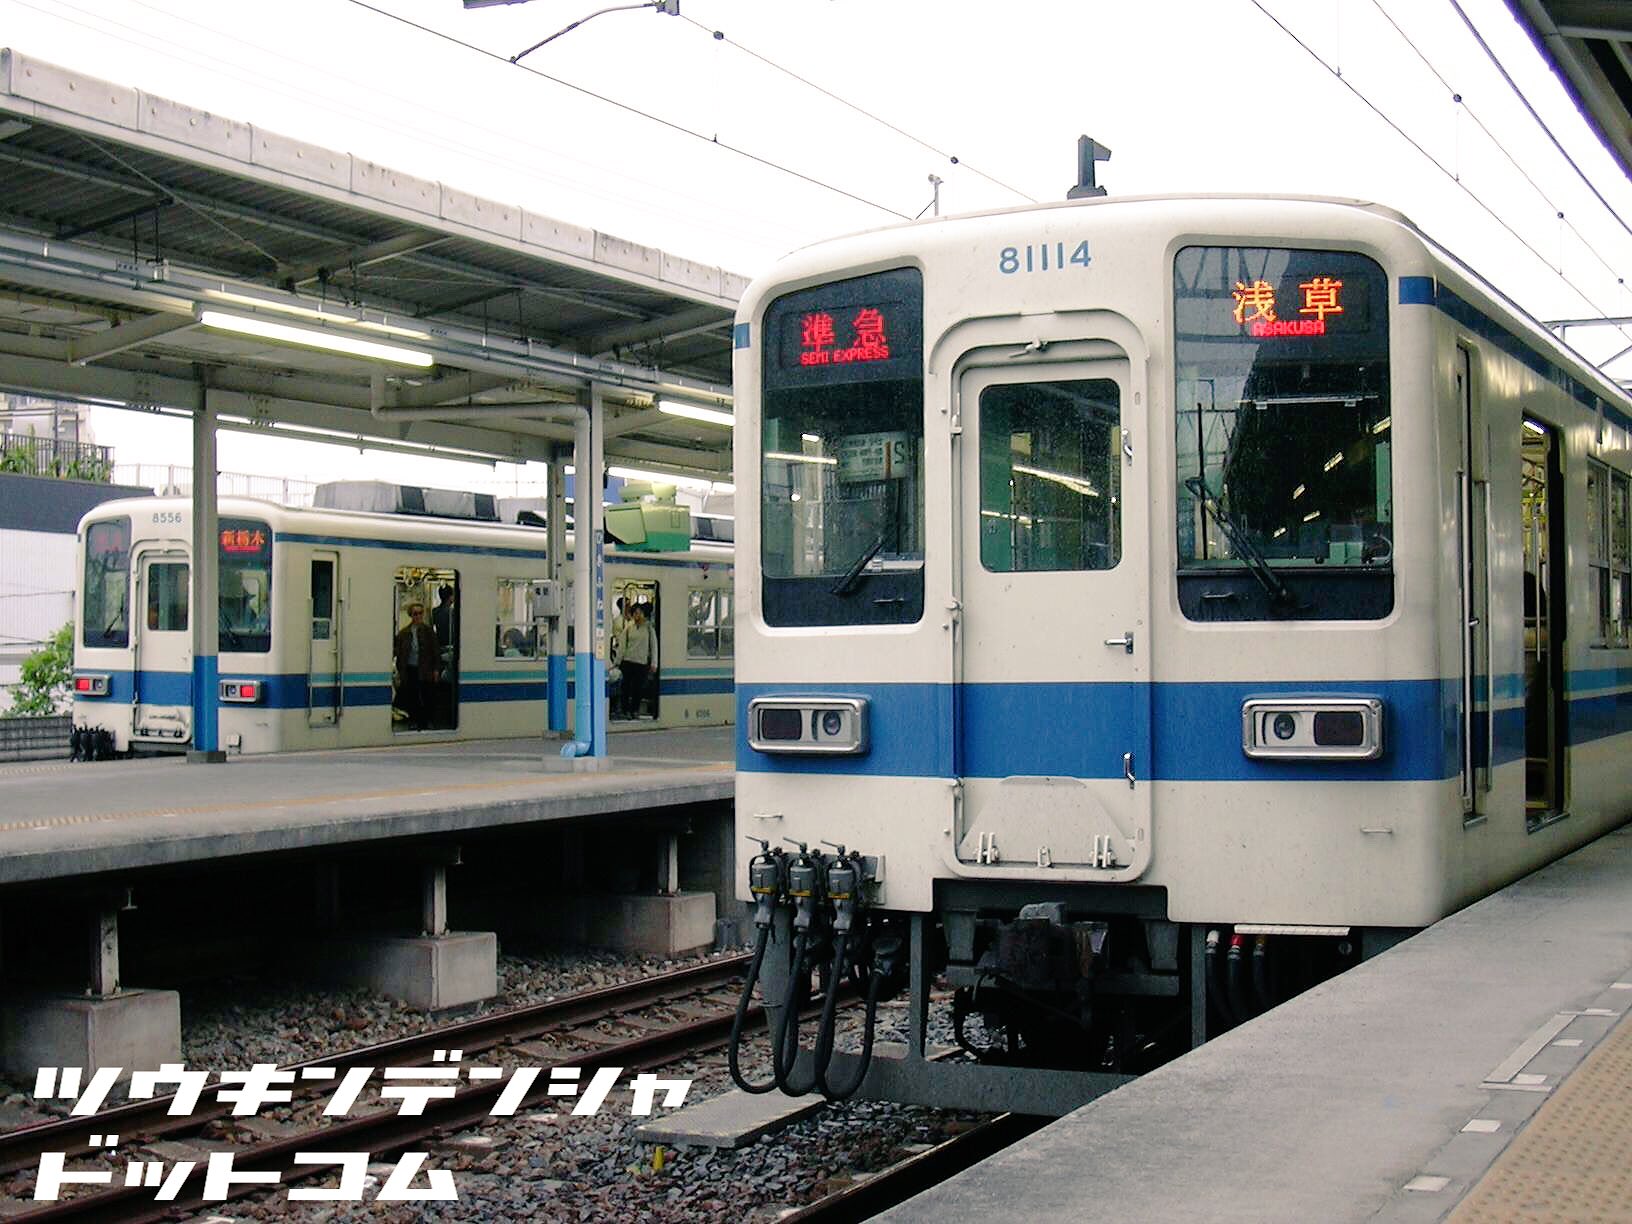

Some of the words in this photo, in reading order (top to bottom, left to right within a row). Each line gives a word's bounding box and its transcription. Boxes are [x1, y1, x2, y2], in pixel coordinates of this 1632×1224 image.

[999, 239, 1091, 274] 81114
[1232, 277, 1343, 322] 浅草
[802, 308, 887, 353] 準急
[1252, 320, 1326, 337] ASAKUSA
[801, 351, 829, 367] SEMI
[832, 344, 889, 363] EXPRESS
[152, 512, 182, 524] 8556
